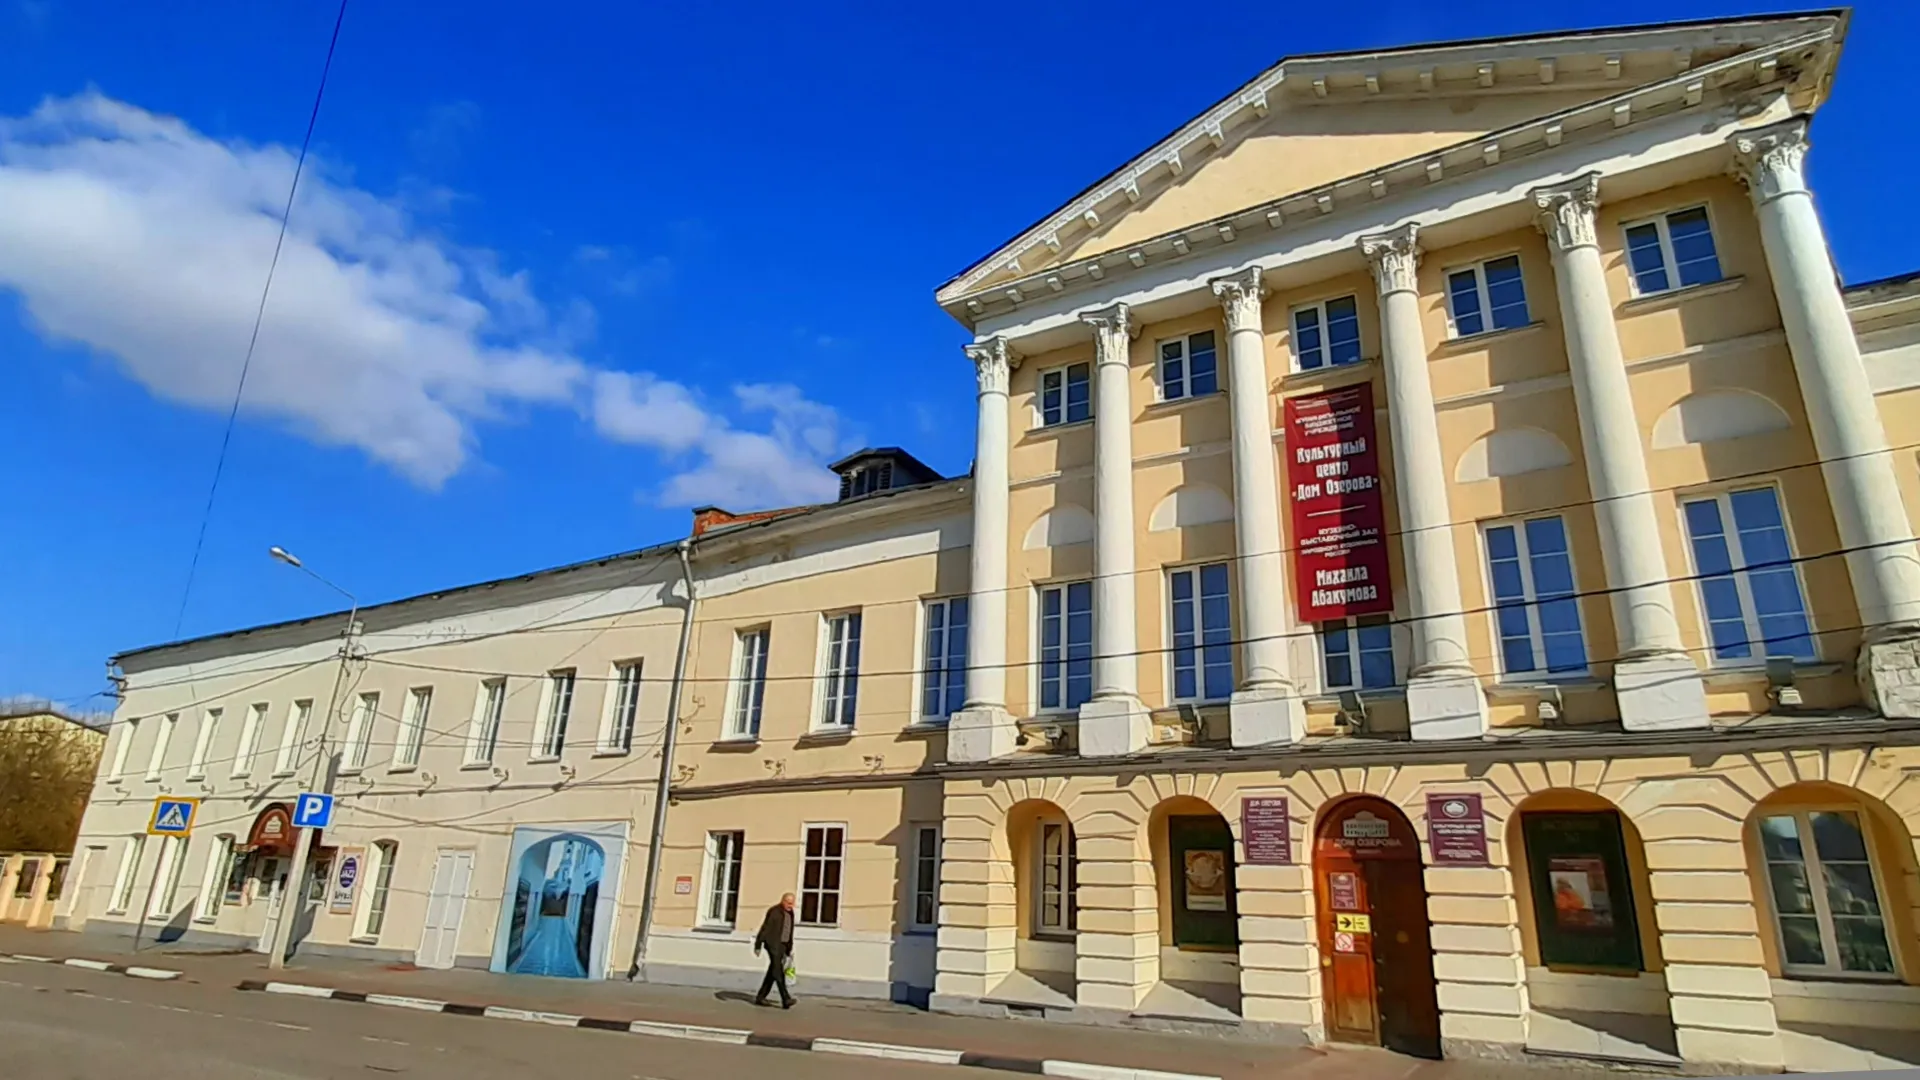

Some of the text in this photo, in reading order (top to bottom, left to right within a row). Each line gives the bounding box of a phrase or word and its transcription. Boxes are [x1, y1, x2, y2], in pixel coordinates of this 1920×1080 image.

[1296, 437, 1366, 463] Культурный
[1316, 461, 1349, 478] центр
[1316, 565, 1368, 587] Михаила
[1312, 584, 1377, 607] Абакумова
[302, 797, 323, 823] P
